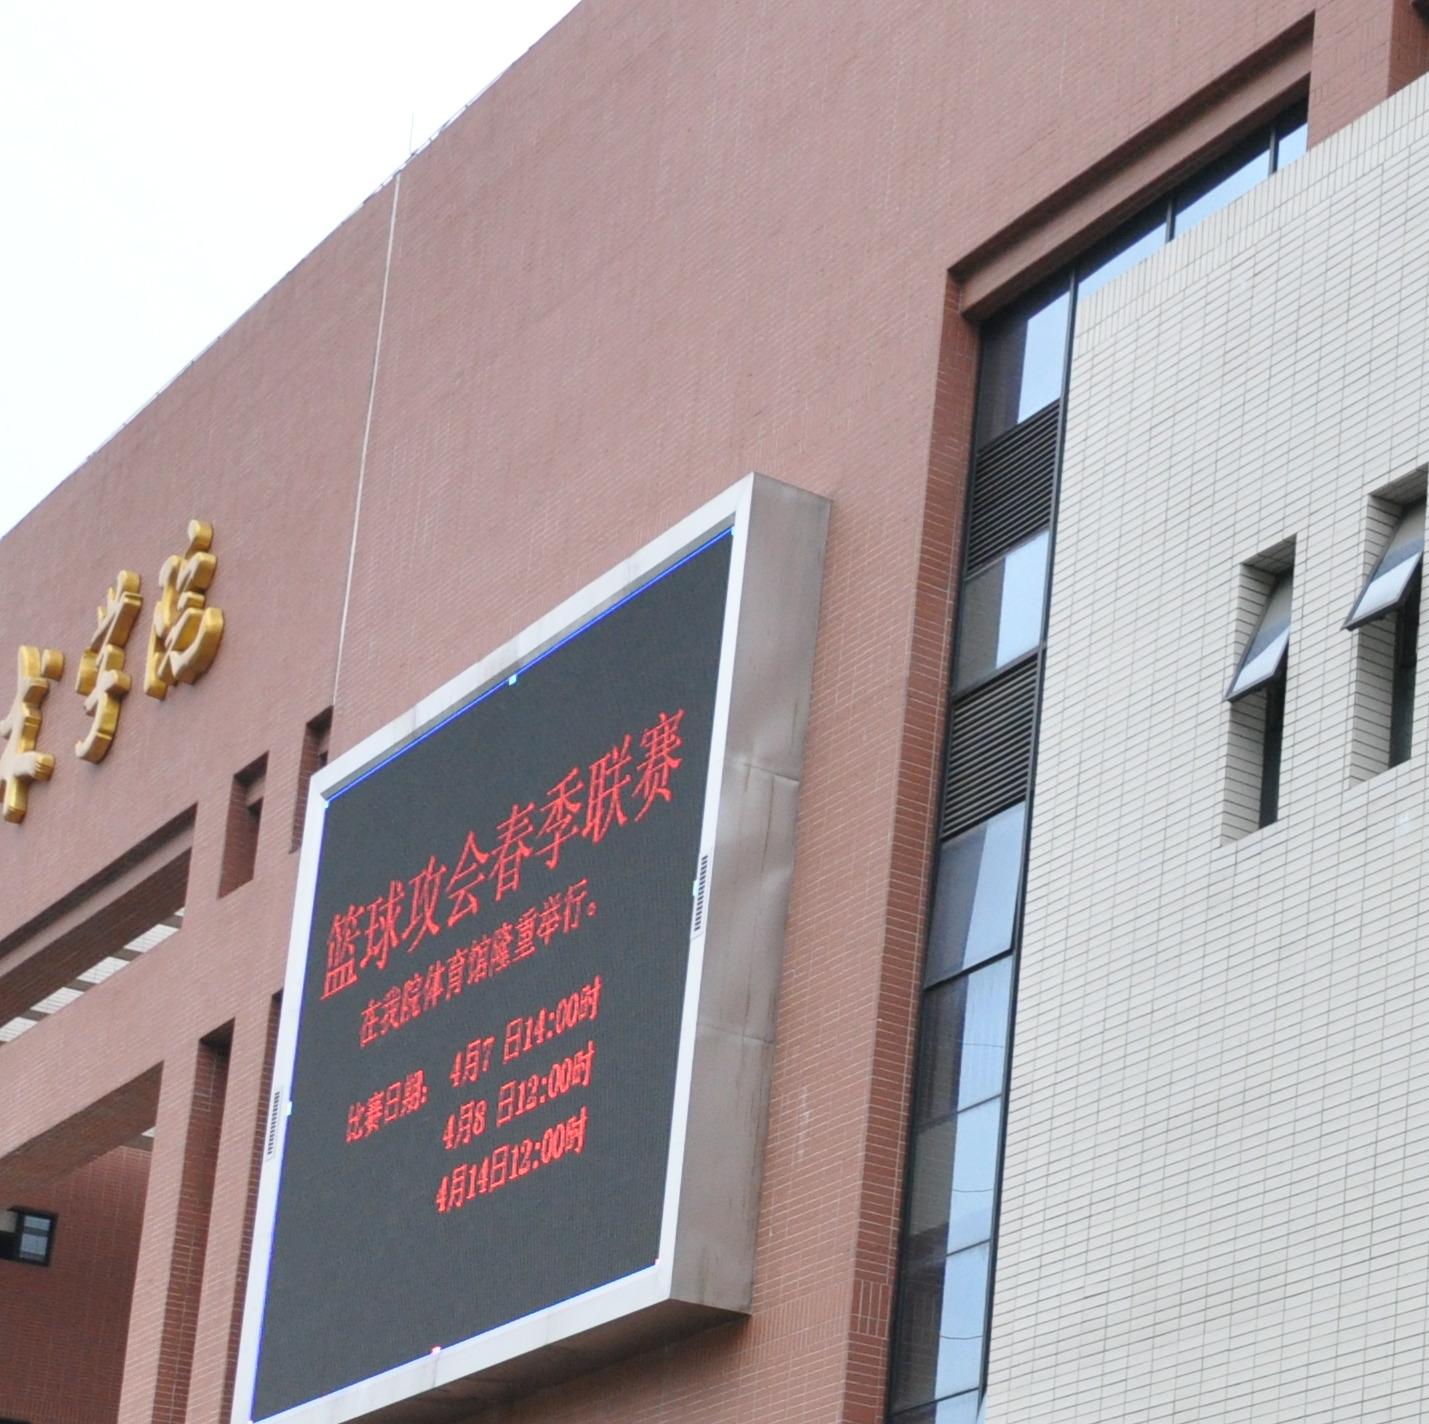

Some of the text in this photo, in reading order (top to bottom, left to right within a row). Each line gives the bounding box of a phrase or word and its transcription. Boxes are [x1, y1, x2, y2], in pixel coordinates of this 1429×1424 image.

[321, 708, 685, 1000] 篮球攻会春季联赛
[435, 1105, 588, 1214] 4月14日12:00时
